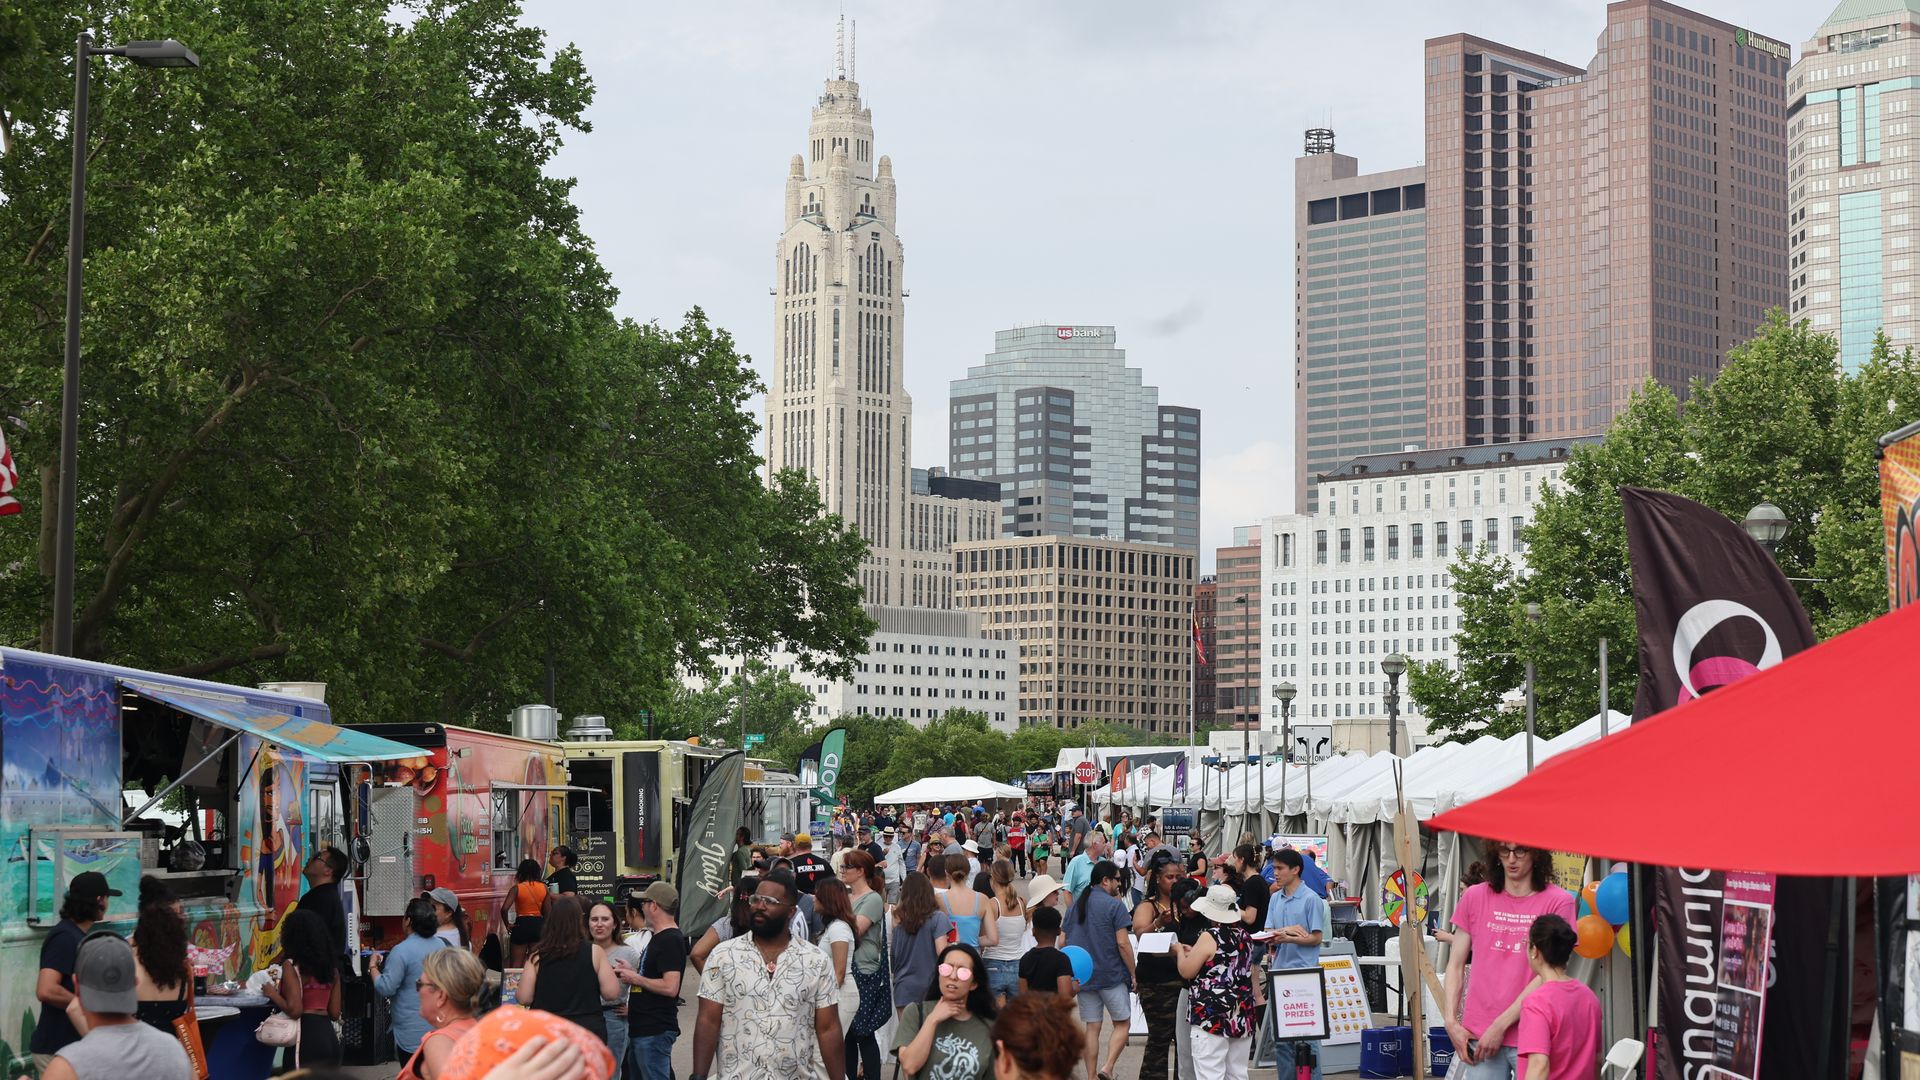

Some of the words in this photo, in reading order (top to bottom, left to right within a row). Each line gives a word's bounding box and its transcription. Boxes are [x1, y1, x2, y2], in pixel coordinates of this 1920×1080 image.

[1747, 31, 1790, 59] Huntington
[1076, 768, 1096, 778] STOP
[638, 815, 645, 827] NO
[704, 792, 720, 839] LITTLE
[694, 840, 726, 898] Italy
[1283, 1002, 1309, 1011] GAME
[1285, 1010, 1315, 1018] PRIZES
